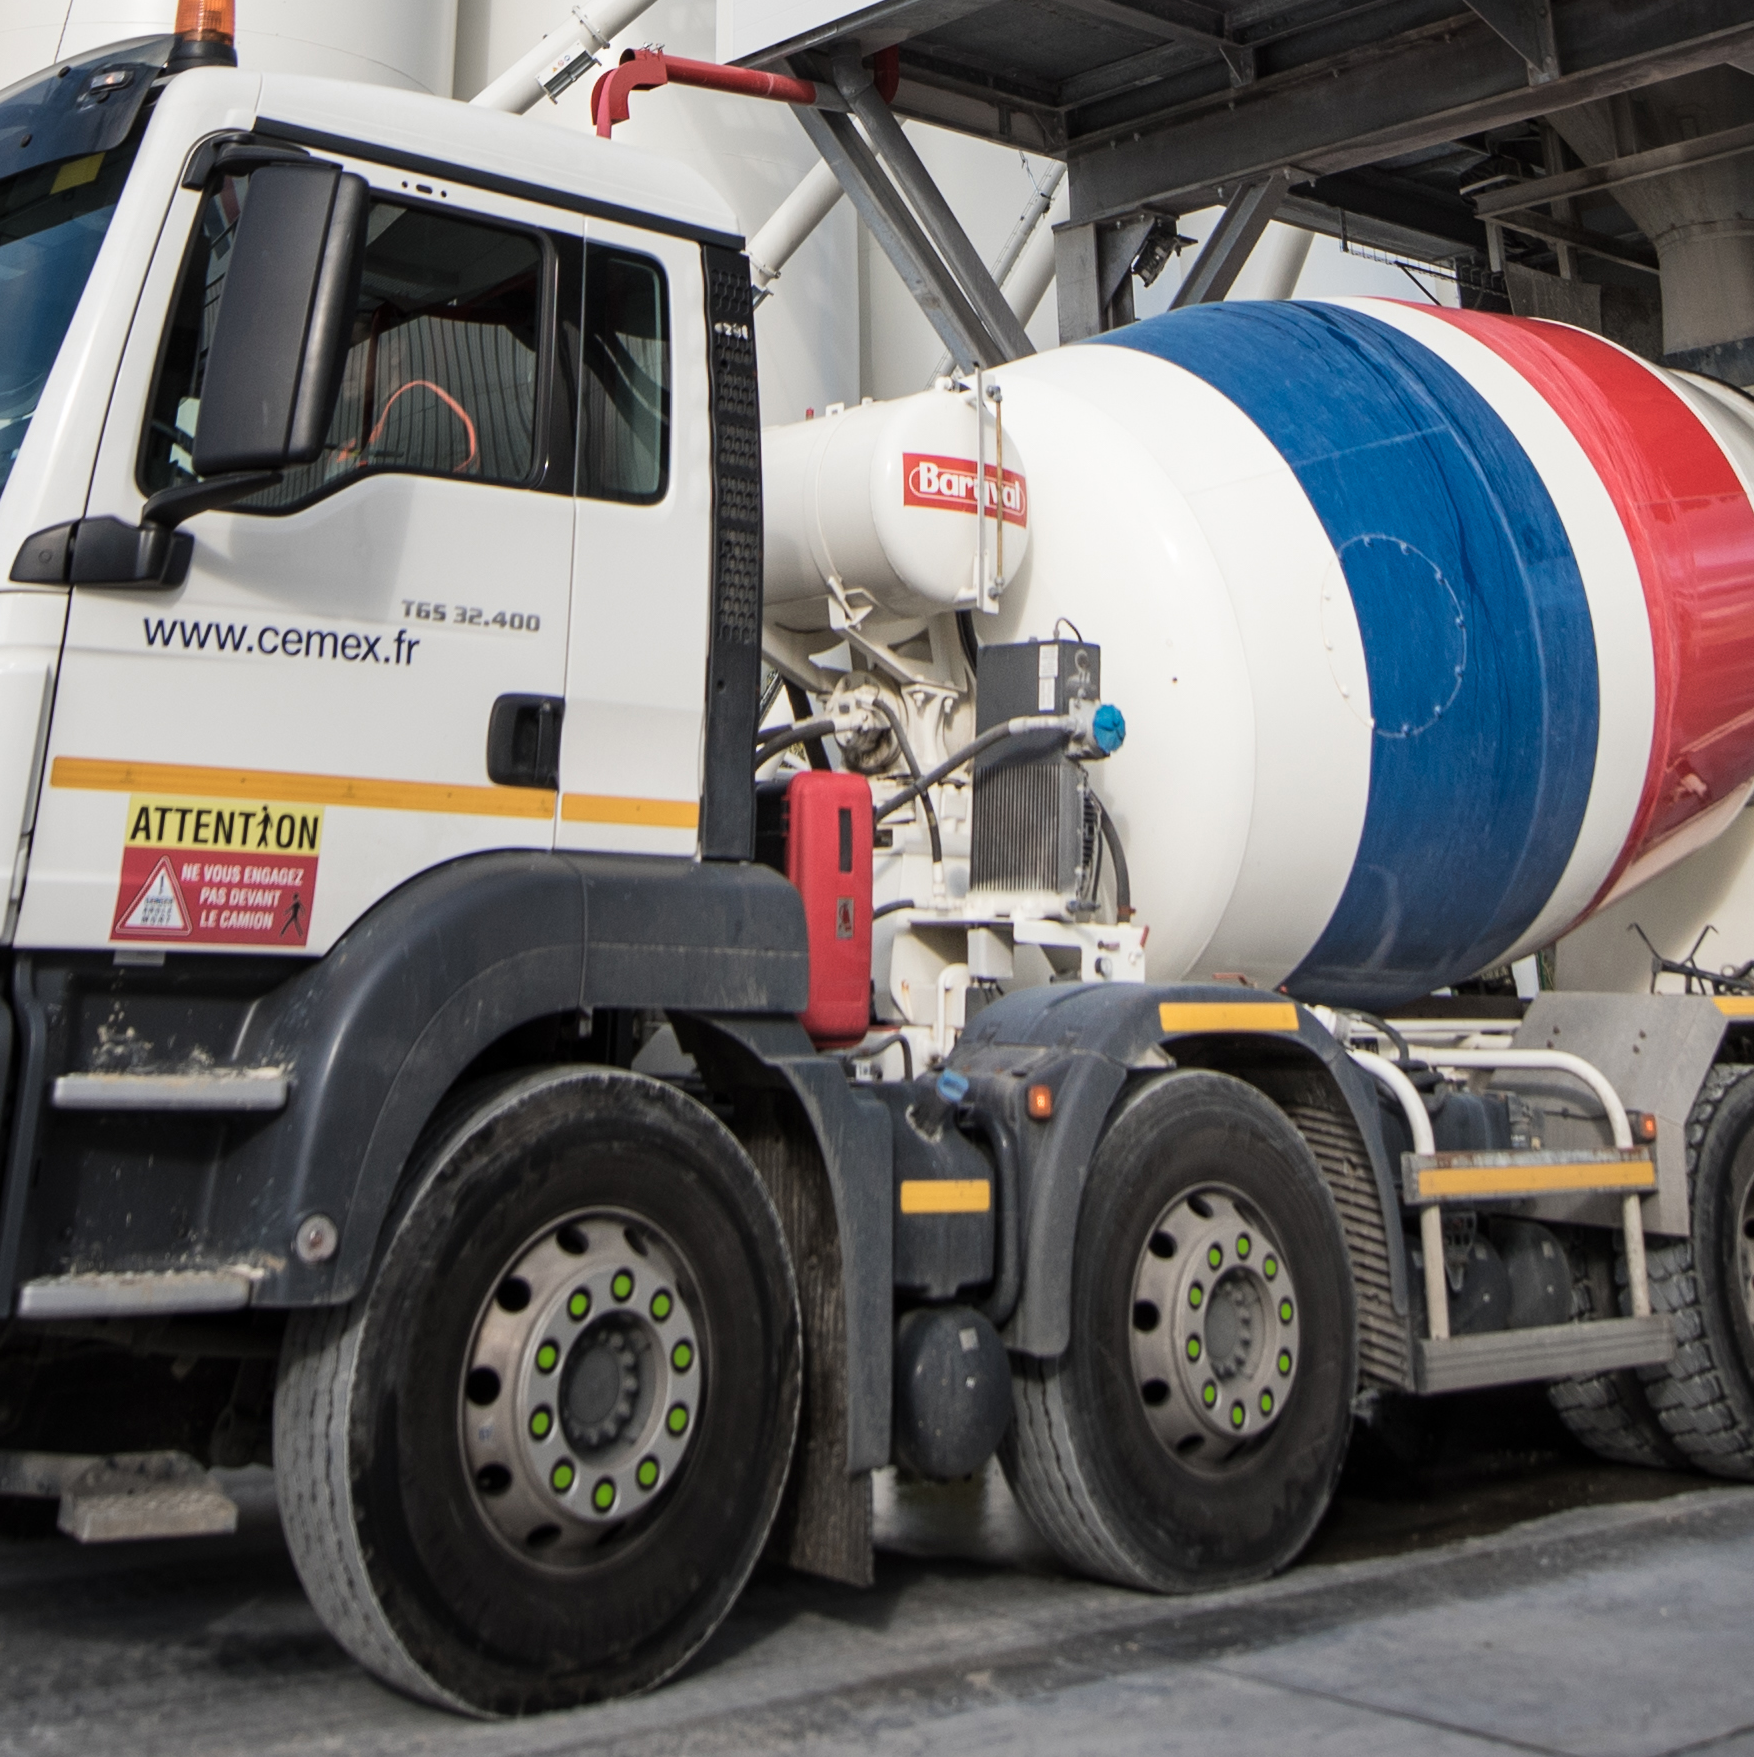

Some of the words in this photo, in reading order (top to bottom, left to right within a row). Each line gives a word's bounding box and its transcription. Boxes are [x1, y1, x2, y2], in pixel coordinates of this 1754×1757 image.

[401, 599, 447, 622] TGS
[453, 605, 541, 632] 32.400
[143, 617, 421, 666] www.cemex.fr
[129, 803, 320, 851] ATTENTION
[181, 862, 200, 882] NE
[204, 863, 241, 884] VOUS
[243, 865, 305, 887] ENGAGEZ
[199, 886, 226, 906] PAS
[229, 888, 282, 908] DEVANT
[199, 909, 217, 929] LE
[219, 910, 274, 931] CAMION
